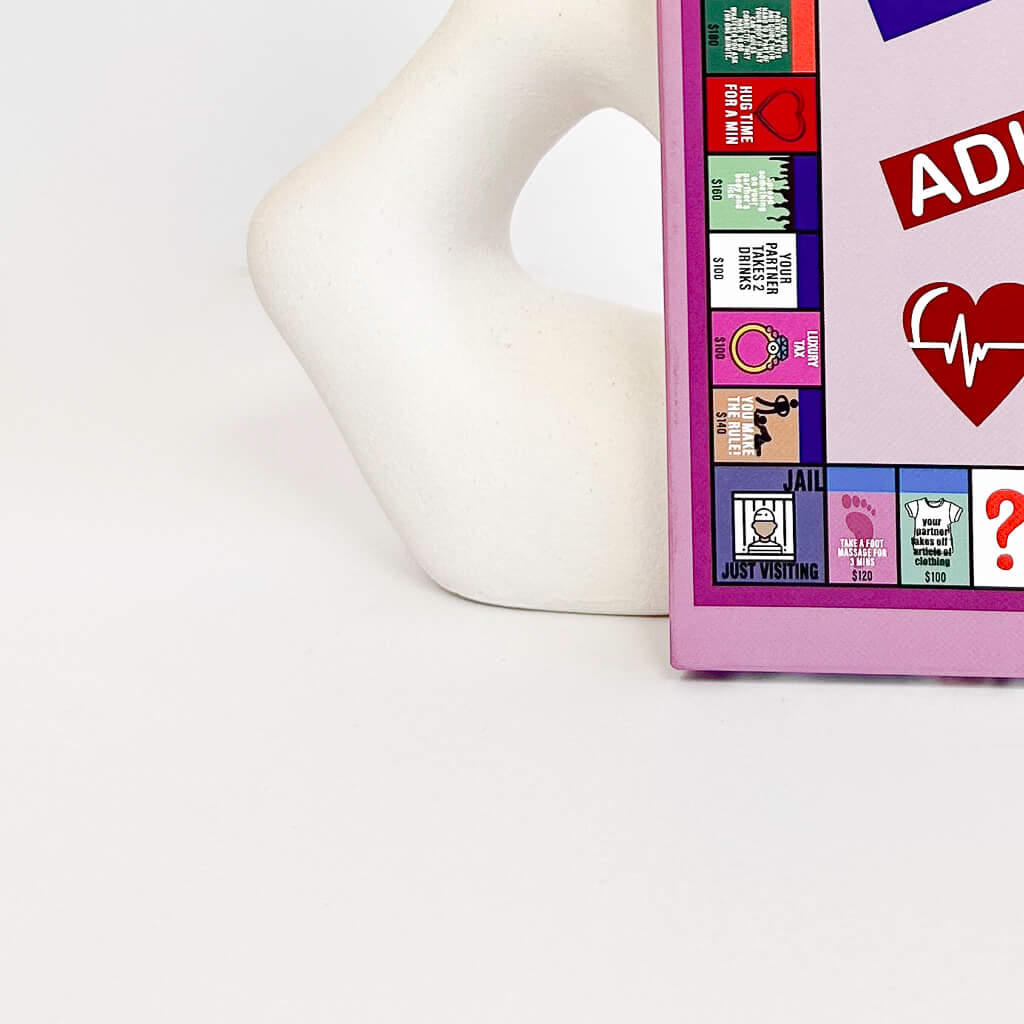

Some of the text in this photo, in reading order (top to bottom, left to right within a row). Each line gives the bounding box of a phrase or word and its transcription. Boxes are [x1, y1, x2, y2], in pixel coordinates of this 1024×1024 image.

[724, 84, 739, 145] FOR A MIN
[739, 85, 753, 143] HUG TIME
[713, 257, 724, 280] $100
[738, 247, 751, 291] DRINKS
[752, 245, 765, 281] TAKES
[765, 242, 779, 295] PARTNER
[780, 253, 792, 284] YOUR
[714, 336, 726, 360] $100
[794, 340, 805, 358] TAX
[807, 331, 819, 367] LUXURY
[716, 411, 727, 435] $140
[728, 396, 741, 455] THE RULE!
[741, 396, 755, 456] YOU MAKE
[783, 469, 825, 492] JAIL
[838, 548, 888, 557] MASSAGE FOR
[840, 539, 858, 548] TAKE
[866, 539, 884, 548] FOOT
[722, 563, 818, 580] JUST VISITING
[856, 558, 876, 566] MINS
[852, 570, 873, 582] $120
[925, 571, 946, 583] $100
